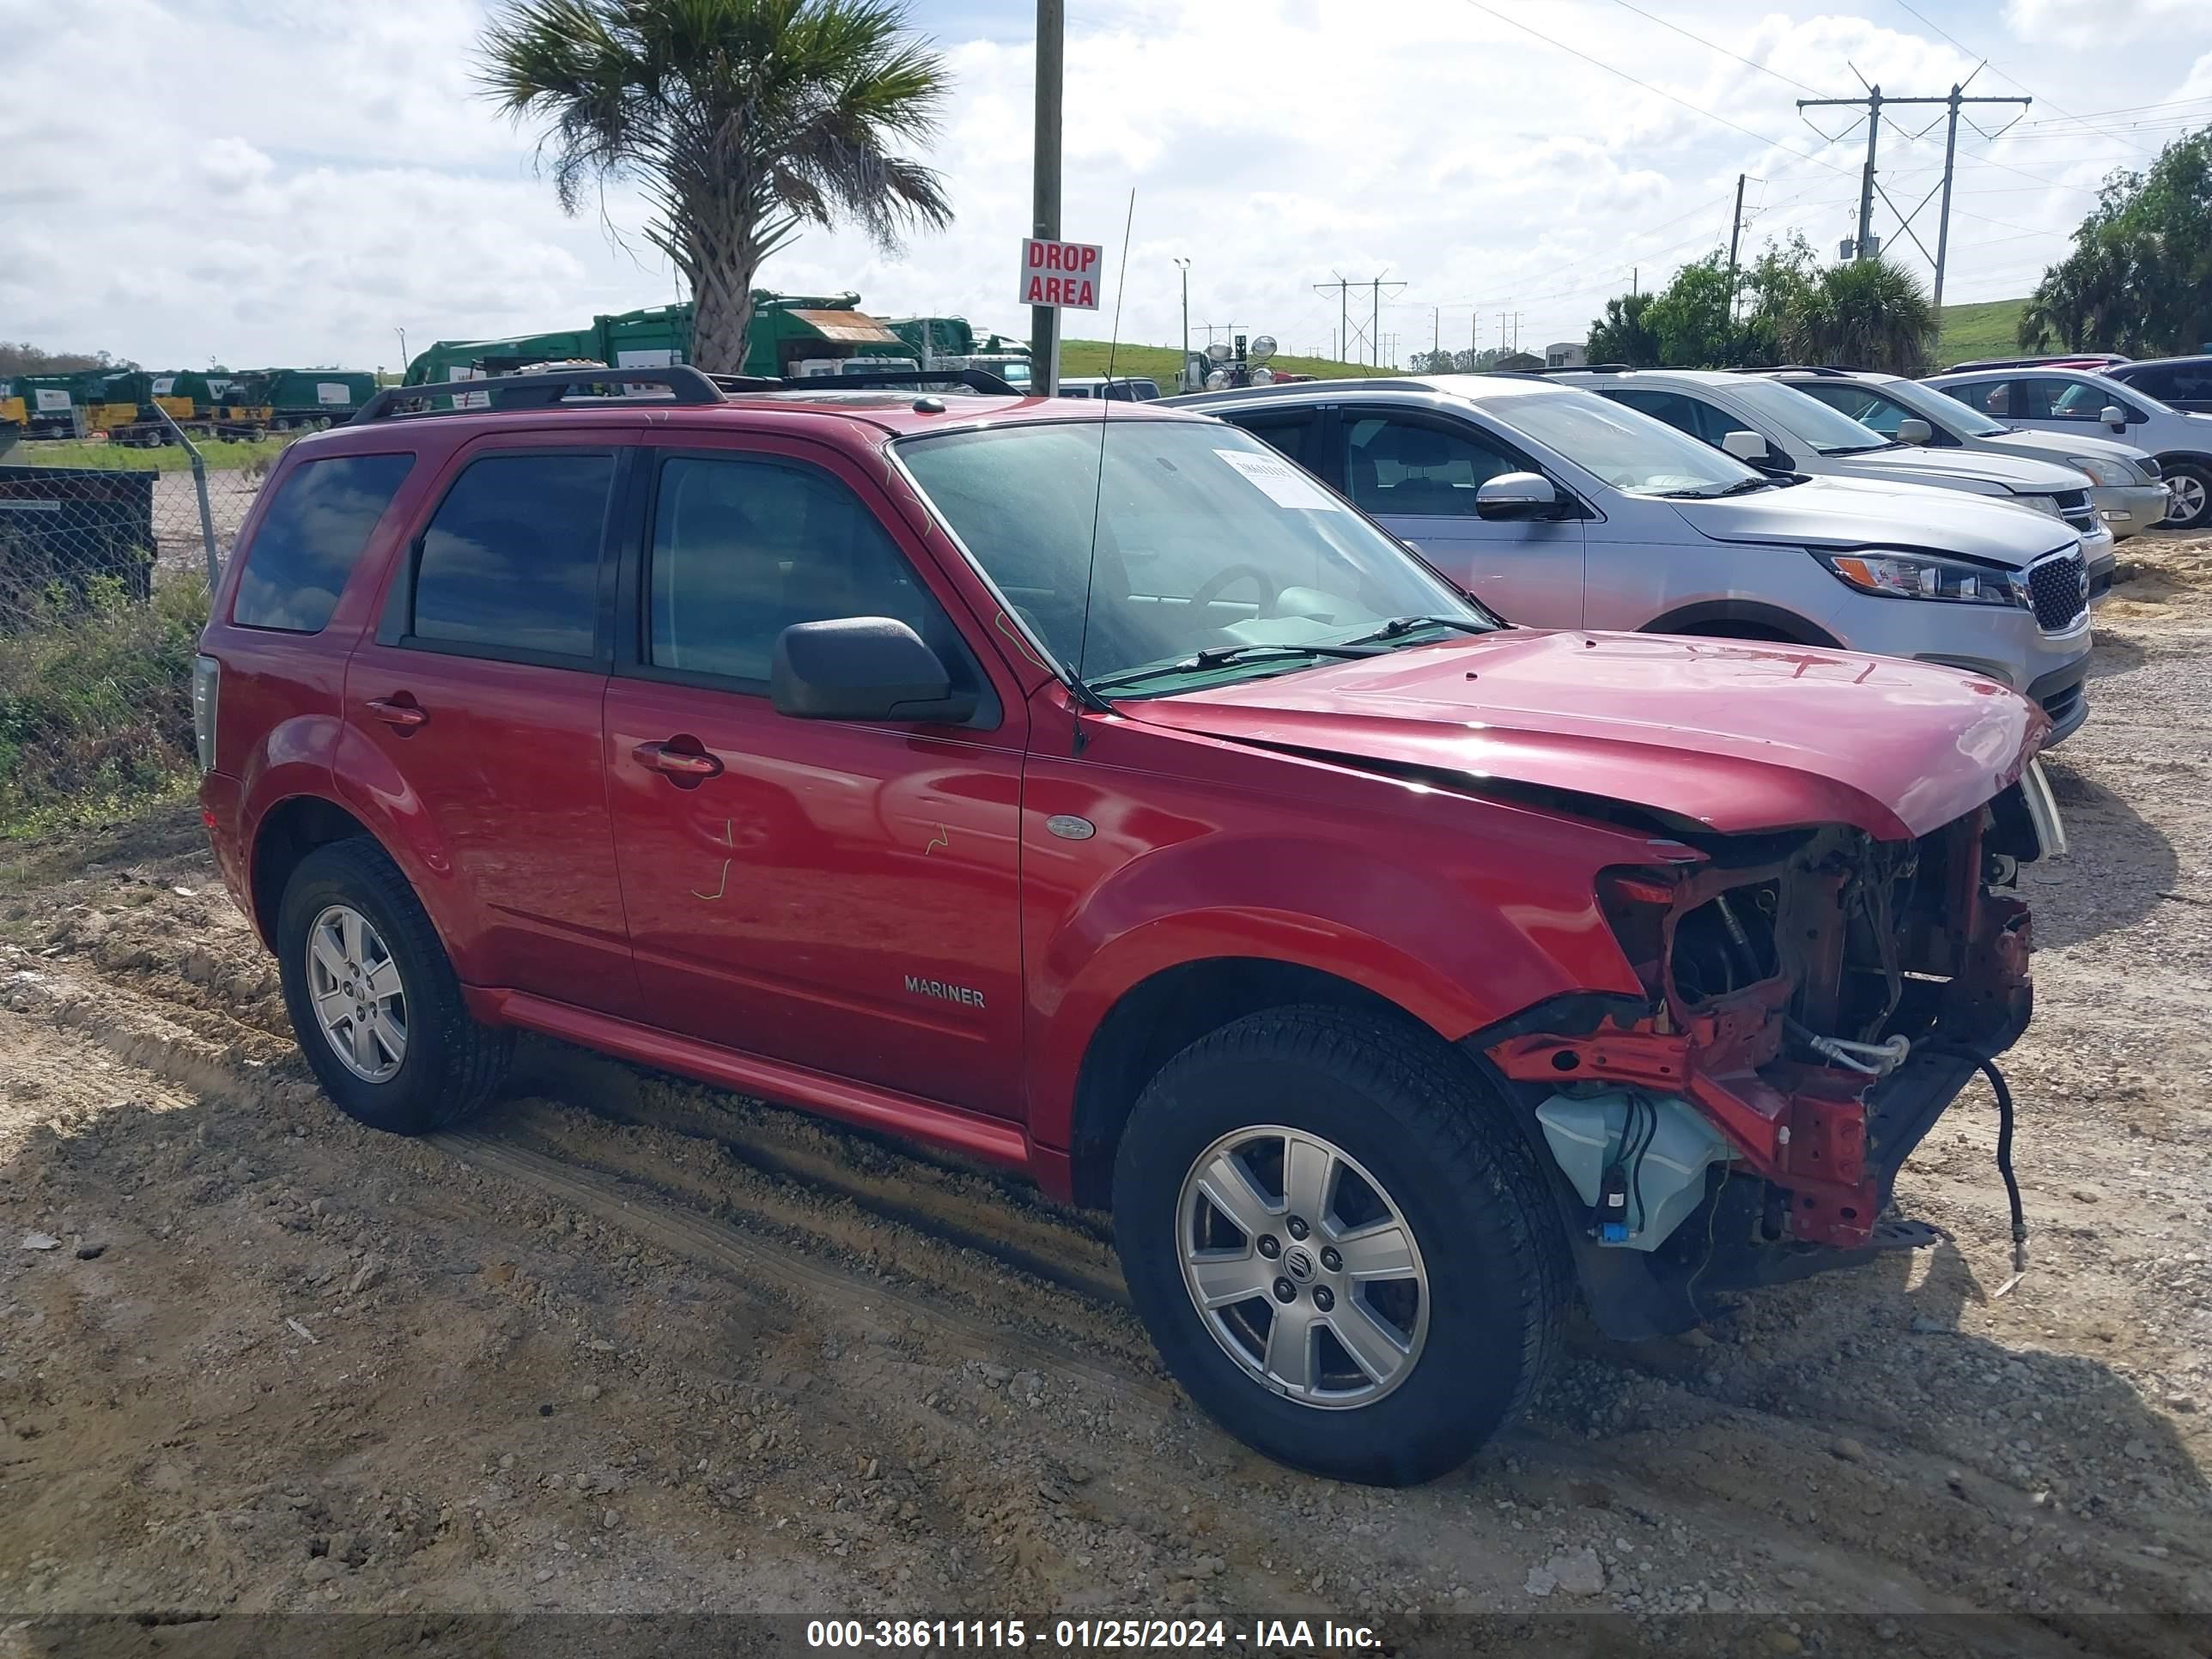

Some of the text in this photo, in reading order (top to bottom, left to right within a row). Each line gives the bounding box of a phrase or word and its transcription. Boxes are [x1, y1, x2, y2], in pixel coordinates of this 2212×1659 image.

[1029, 241, 1097, 272] DROP
[1028, 276, 1093, 307] AREA
[904, 975, 985, 1007] MARINER
